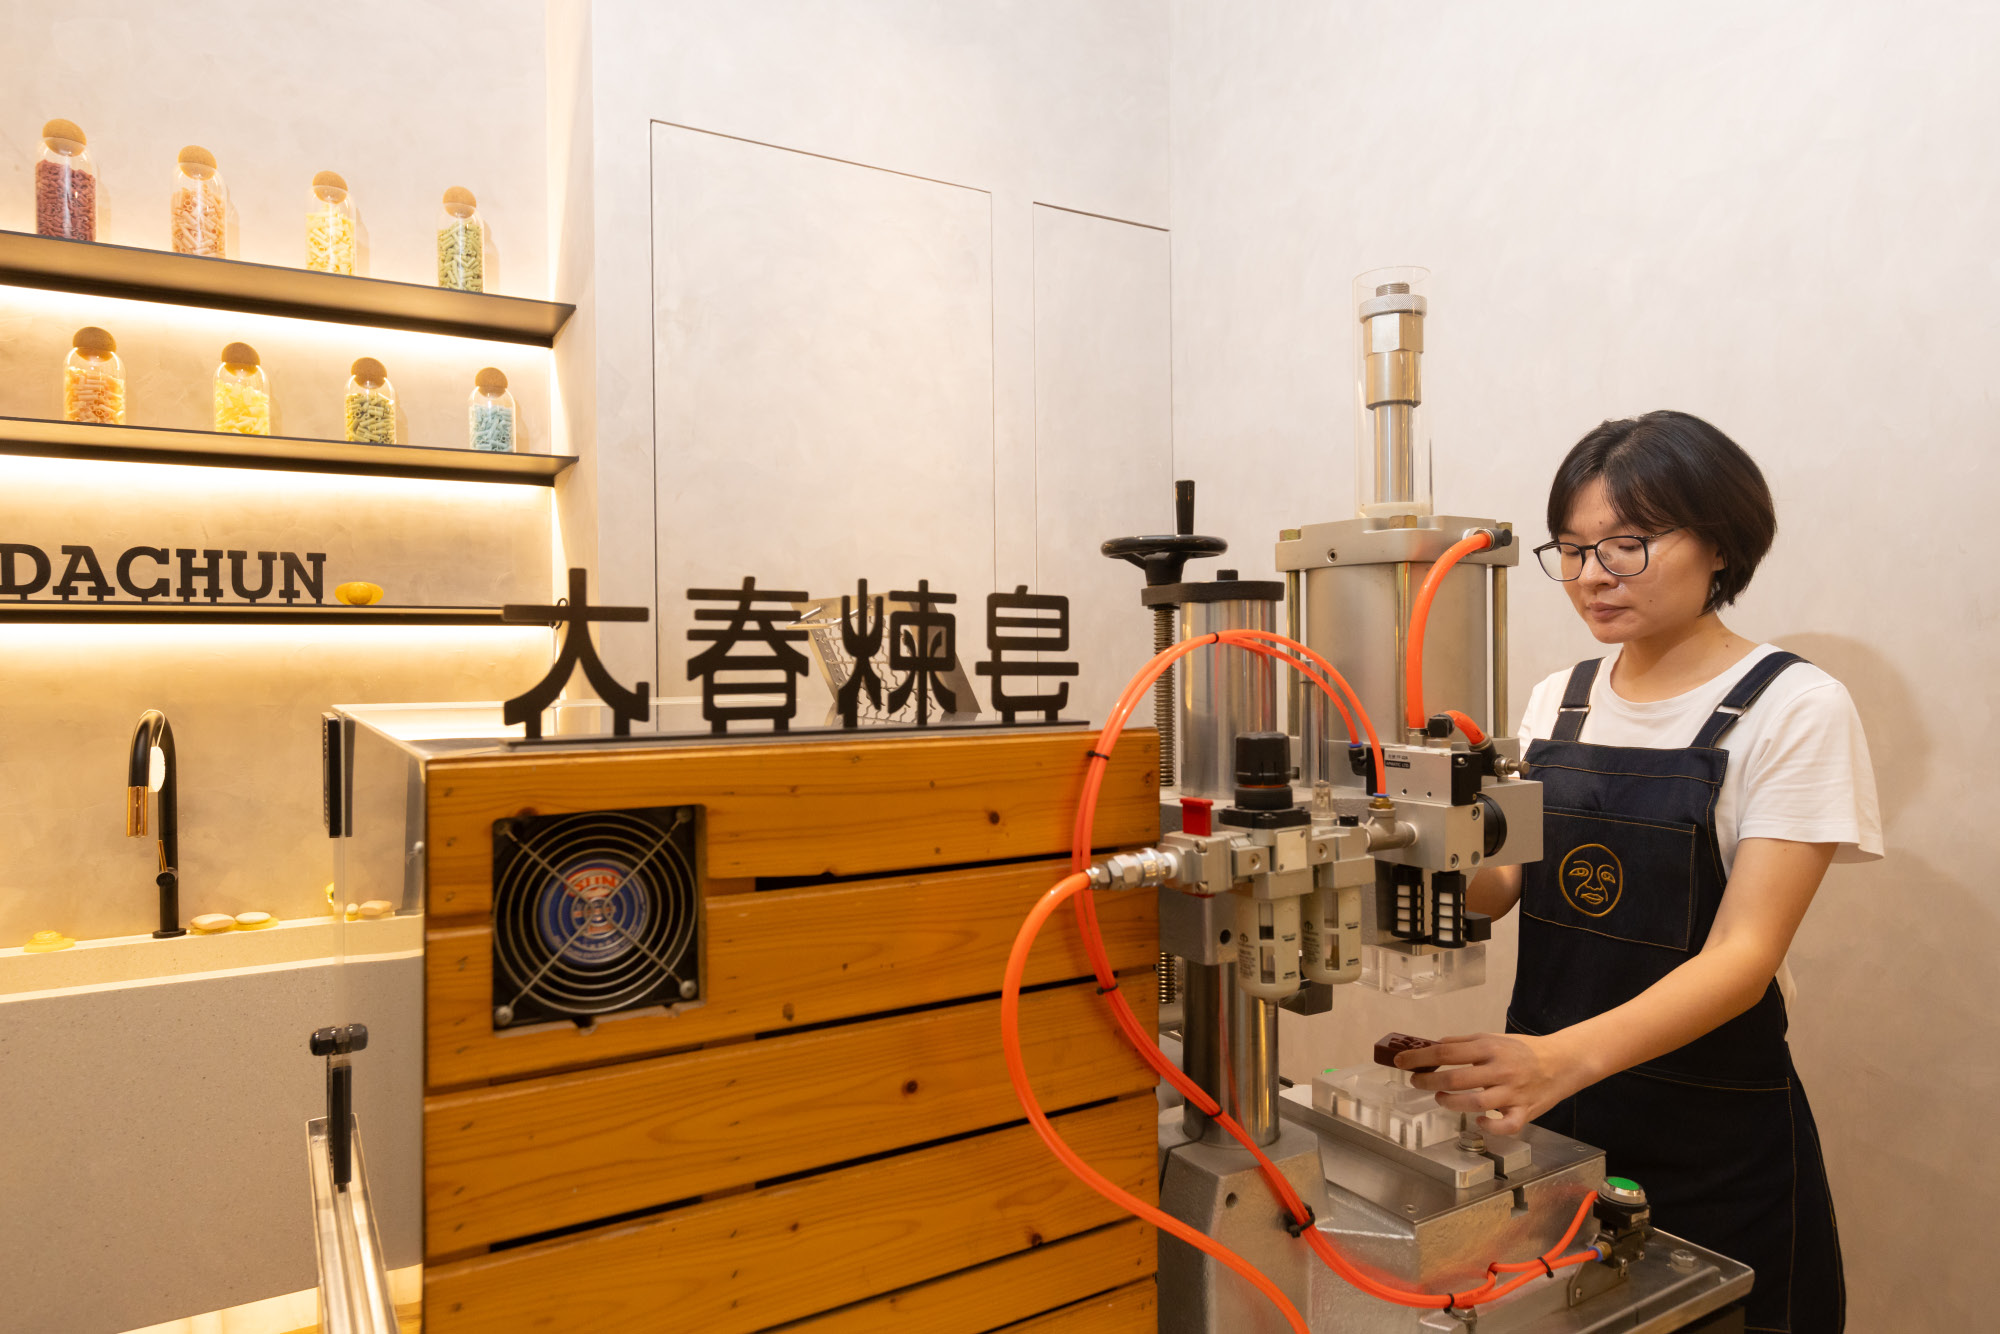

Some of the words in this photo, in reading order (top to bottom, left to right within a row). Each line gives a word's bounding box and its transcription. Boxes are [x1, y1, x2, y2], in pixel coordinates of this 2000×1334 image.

[0, 543, 327, 602] DACHUN
[504, 568, 1080, 728] 大春煉皂
